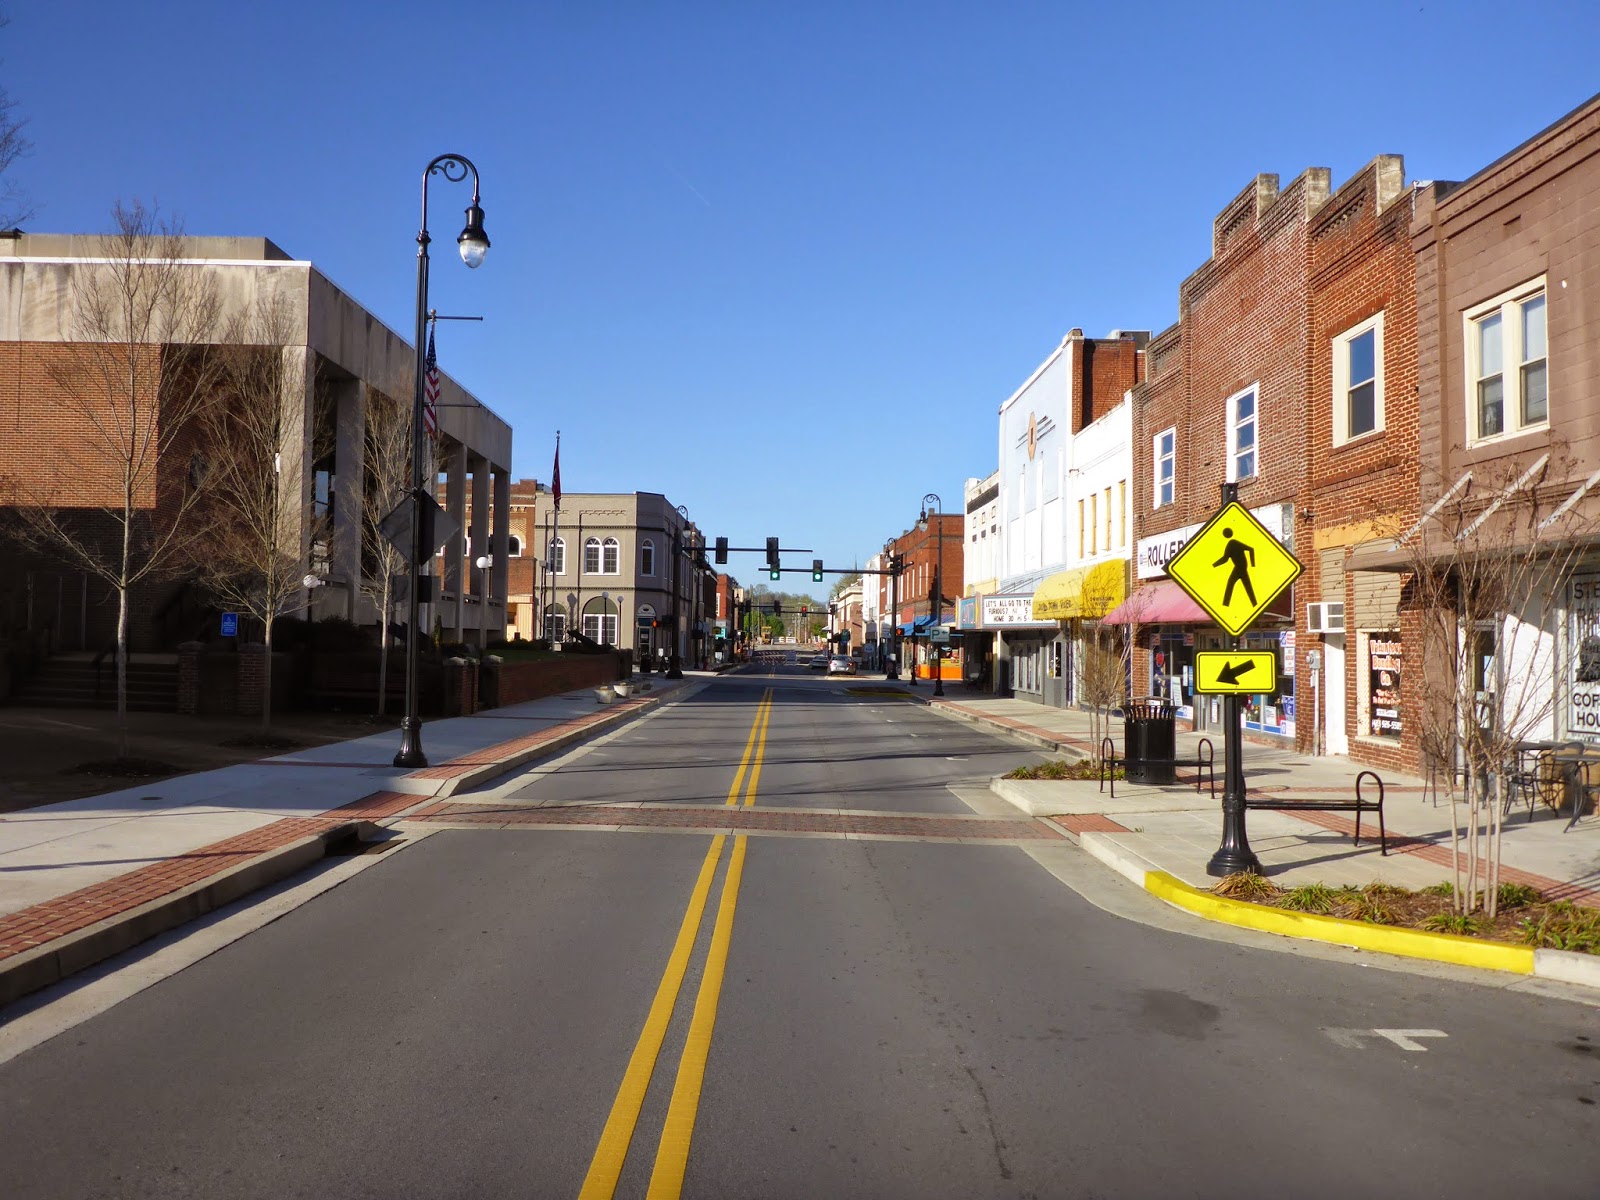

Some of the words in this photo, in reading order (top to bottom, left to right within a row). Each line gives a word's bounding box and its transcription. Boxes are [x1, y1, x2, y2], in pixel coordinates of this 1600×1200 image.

[985, 600, 997, 608] LET'S
[1008, 599, 1015, 607] GO
[1016, 599, 1022, 607] TO
[931, 630, 940, 640] P
